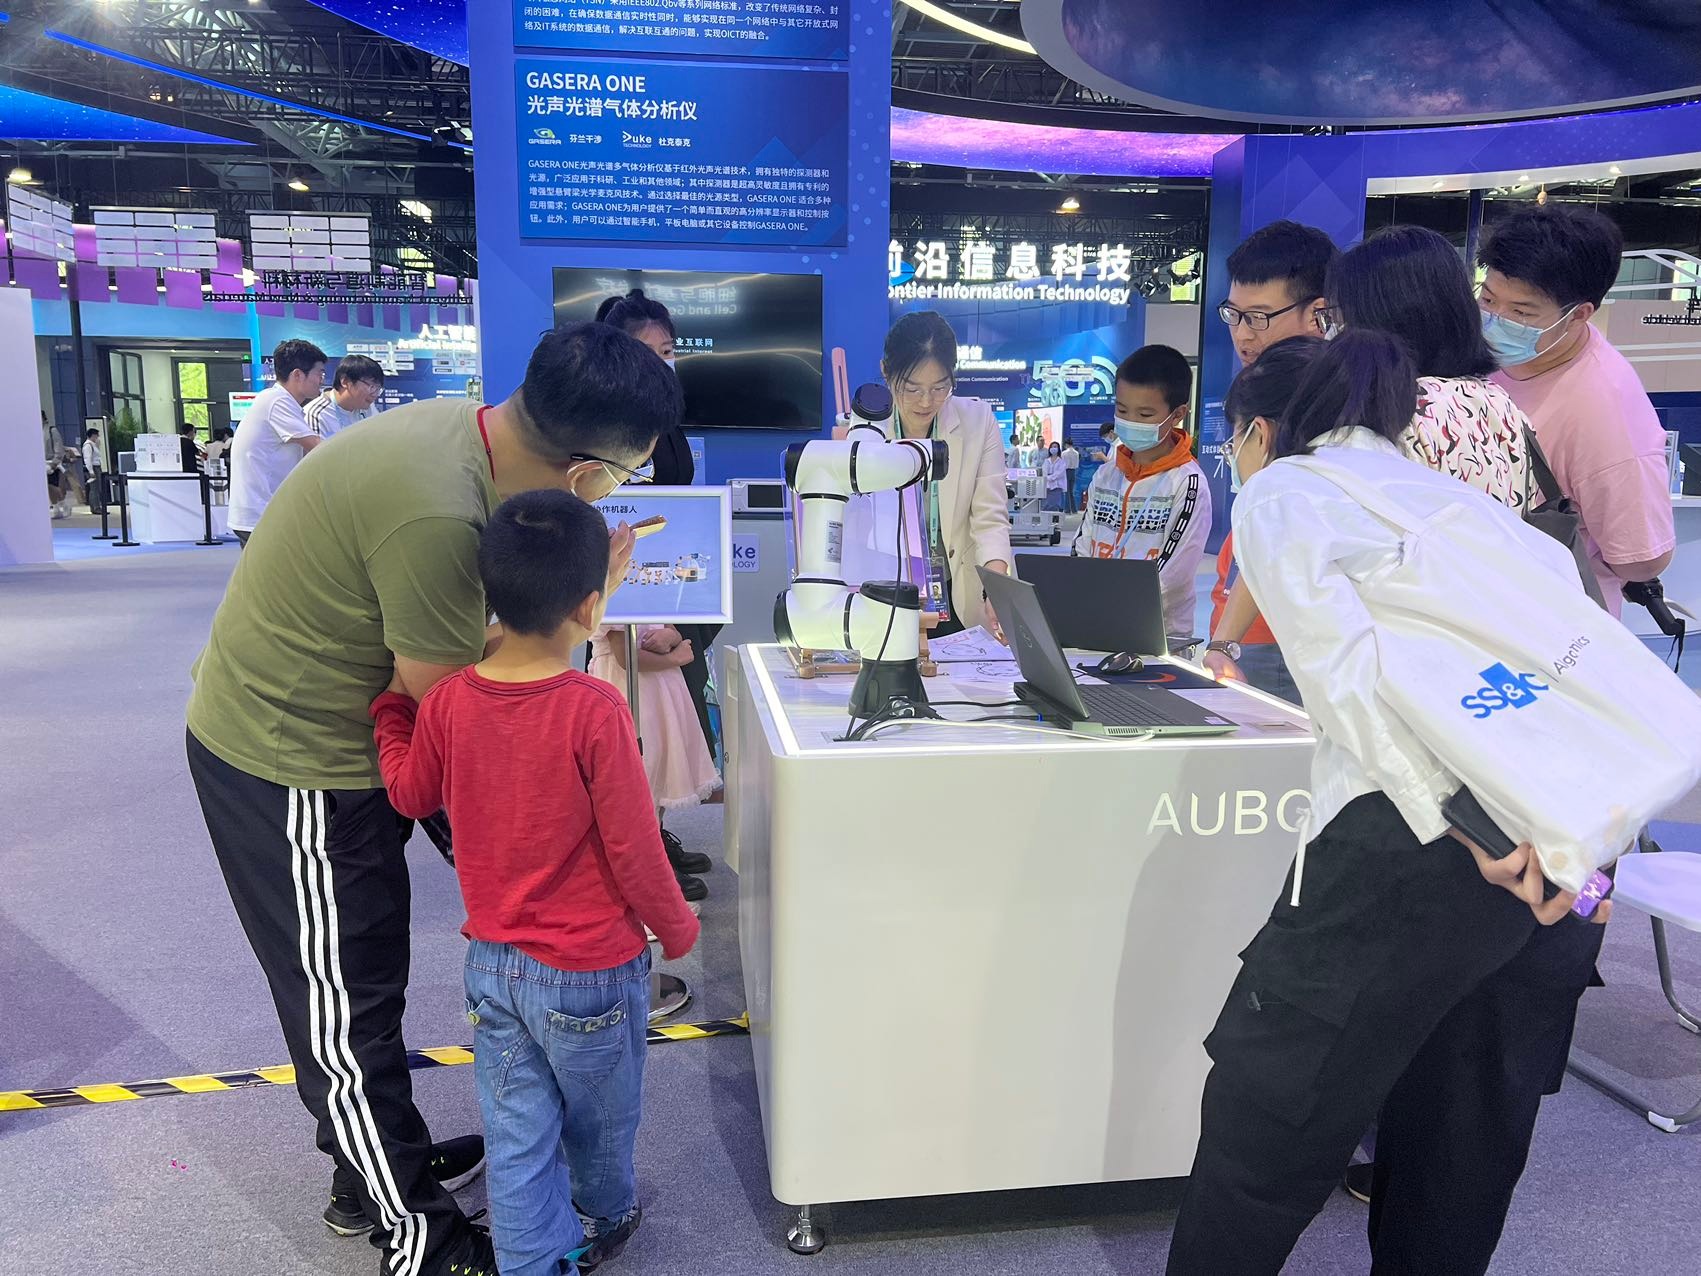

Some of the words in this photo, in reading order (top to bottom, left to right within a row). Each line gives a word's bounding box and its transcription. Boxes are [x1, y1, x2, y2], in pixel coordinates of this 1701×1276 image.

[526, 71, 602, 91] GASERA
[605, 75, 646, 93] ONE
[527, 95, 698, 121] 光声光谱气体分析仪
[569, 134, 602, 144] 芬兰干涉
[658, 137, 692, 147] 杜克泰克
[528, 160, 561, 169] GASERA
[779, 196, 797, 204] ONE
[888, 281, 937, 300] ontier
[937, 281, 1034, 300] Information
[1037, 284, 1130, 304] Technology
[672, 337, 713, 347] 业互联网
[733, 543, 756, 559] ke
[1146, 788, 1313, 837] AUBO
